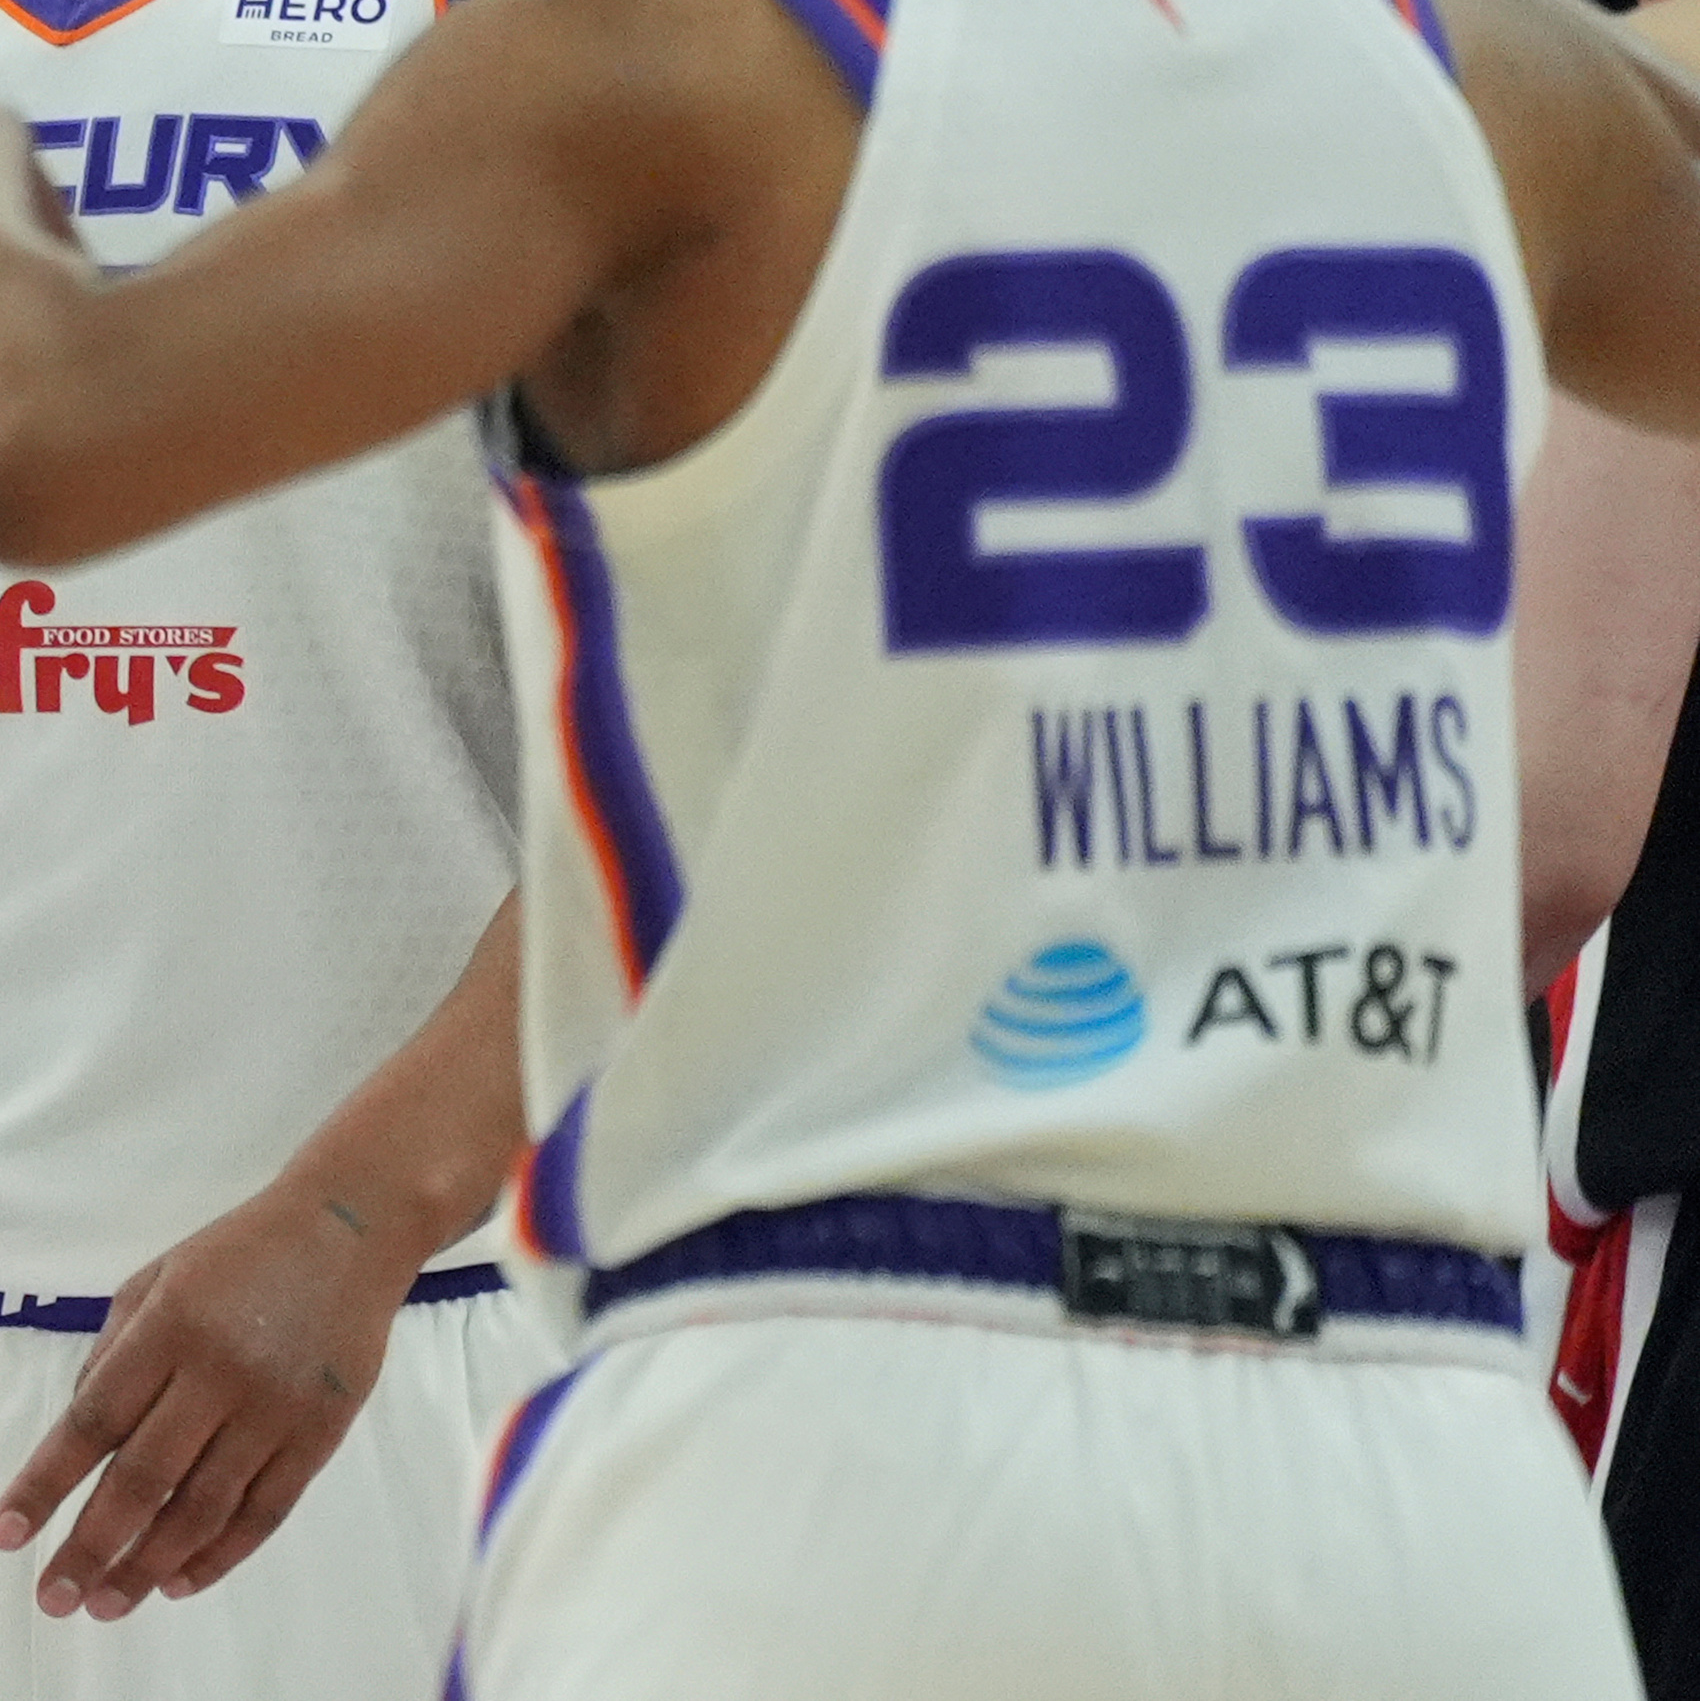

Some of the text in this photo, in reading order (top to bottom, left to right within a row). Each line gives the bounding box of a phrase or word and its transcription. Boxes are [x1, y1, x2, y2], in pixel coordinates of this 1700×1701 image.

[270, 30, 334, 44] BREAD
[875, 243, 1516, 660] 23
[41, 627, 215, 646] FOOD STORES
[1031, 689, 1478, 872] WILLIAMS
[1183, 940, 1460, 1065] AT&T
